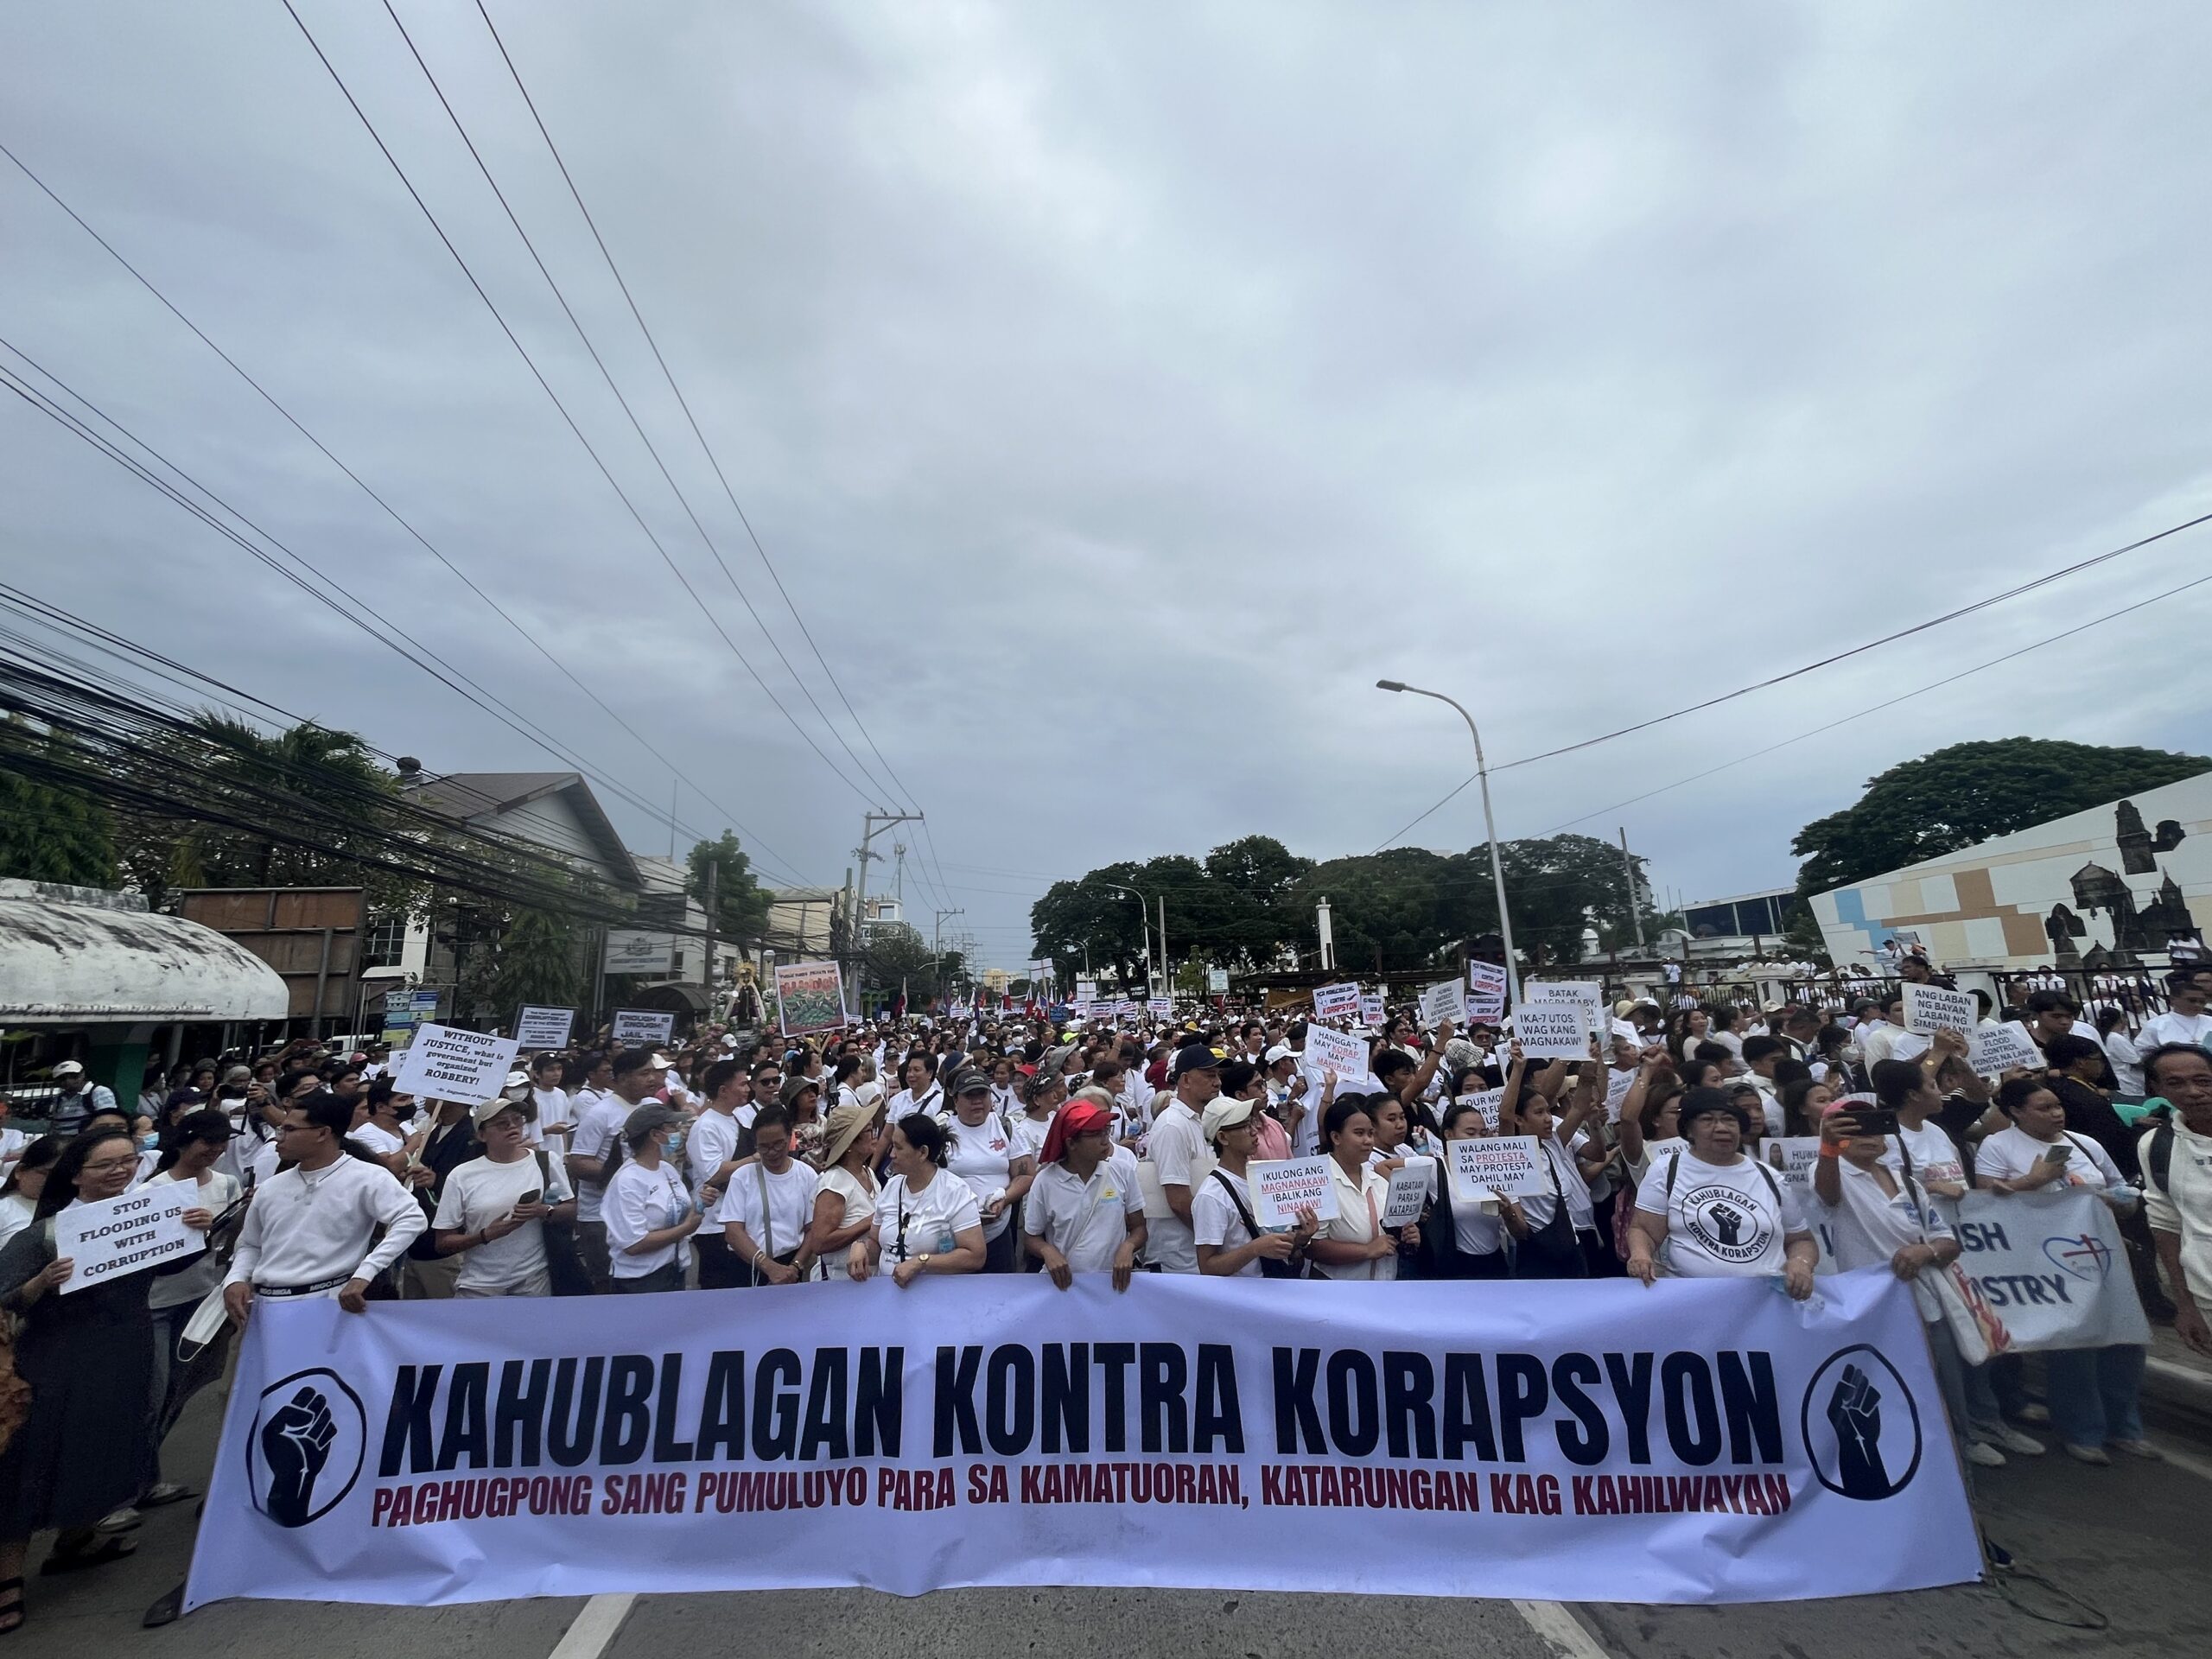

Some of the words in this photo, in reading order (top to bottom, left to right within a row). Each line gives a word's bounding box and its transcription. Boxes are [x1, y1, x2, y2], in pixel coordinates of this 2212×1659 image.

[1915, 989, 1936, 1000] ANG
[1939, 994, 1971, 1006] LABAN
[1918, 1001, 1932, 1009] NG
[1934, 1003, 1969, 1016] BAYAN,
[1521, 1014, 1546, 1023] IKA-7
[1549, 1014, 1576, 1023] UTOS:
[1918, 1010, 1950, 1022] LABAN
[1953, 1015, 1967, 1025] NG
[1522, 1026, 1548, 1034] WAG
[1550, 1026, 1576, 1034] KANG
[444, 1030, 495, 1046] WITHOUT
[1314, 1039, 1331, 1049] MAY
[1319, 1032, 1358, 1050] HANGGA'T
[1520, 1037, 1581, 1046] MAGNAKAW!
[1984, 1037, 2010, 1046] FLOOD
[423, 1039, 471, 1055] JUSTICE,
[474, 1049, 495, 1059] what
[1982, 1044, 2019, 1056] CONTROL
[426, 1051, 476, 1065] government
[479, 1059, 493, 1068] but
[1328, 1052, 1344, 1062] MAY
[1972, 1056, 1999, 1066] FUNDS
[2012, 1048, 2034, 1058] LANG
[436, 1061, 478, 1073] organized
[1976, 1065, 1993, 1074] ANG
[425, 1069, 480, 1085] ROBBERY!
[1466, 1097, 1486, 1106] OUR
[1459, 1143, 1501, 1153] WALANG
[1503, 1141, 1527, 1150] MALI
[1476, 1152, 1529, 1164] PROTESTA,
[1263, 1168, 1303, 1181] IKULONG
[1305, 1166, 1324, 1176] ANG
[1460, 1165, 1484, 1173] MAY
[1484, 1161, 1534, 1172] PROTESTA
[1262, 1176, 1329, 1194] MAGNANAKAW!
[1471, 1173, 1502, 1183] DAHIL
[1504, 1173, 1524, 1181] MAY
[1273, 1190, 1301, 1202] IBALIK
[1303, 1188, 1322, 1198] ANG
[1486, 1184, 1514, 1192] MALI!
[113, 1198, 150, 1215] STOP
[1688, 1189, 1758, 1211] KAHUBLAGAN
[79, 1212, 160, 1243] FLOODING
[165, 1207, 181, 1218] US
[114, 1230, 156, 1249] WITH
[1688, 1222, 1719, 1253] KONTRA
[1720, 1230, 1770, 1258] KORAPSYON
[84, 1239, 184, 1276] CORRUPTION
[378, 1346, 905, 1478] KAHUBLAGAN
[933, 1342, 1245, 1459] KONTRA
[1271, 1346, 1784, 1467] KORAPSYON
[372, 1474, 592, 1527] PAGHUGPONG
[601, 1471, 685, 1516] SANG
[695, 1466, 868, 1514] PUMULUYO
[878, 1466, 957, 1511] PARA
[967, 1463, 1009, 1504] SA
[1020, 1462, 1249, 1510] KAMATUORAN,
[1262, 1465, 1480, 1512] KATARUNGAN
[1490, 1471, 1560, 1516] KAG
[1573, 1473, 1791, 1517] KAHILWAYAN
